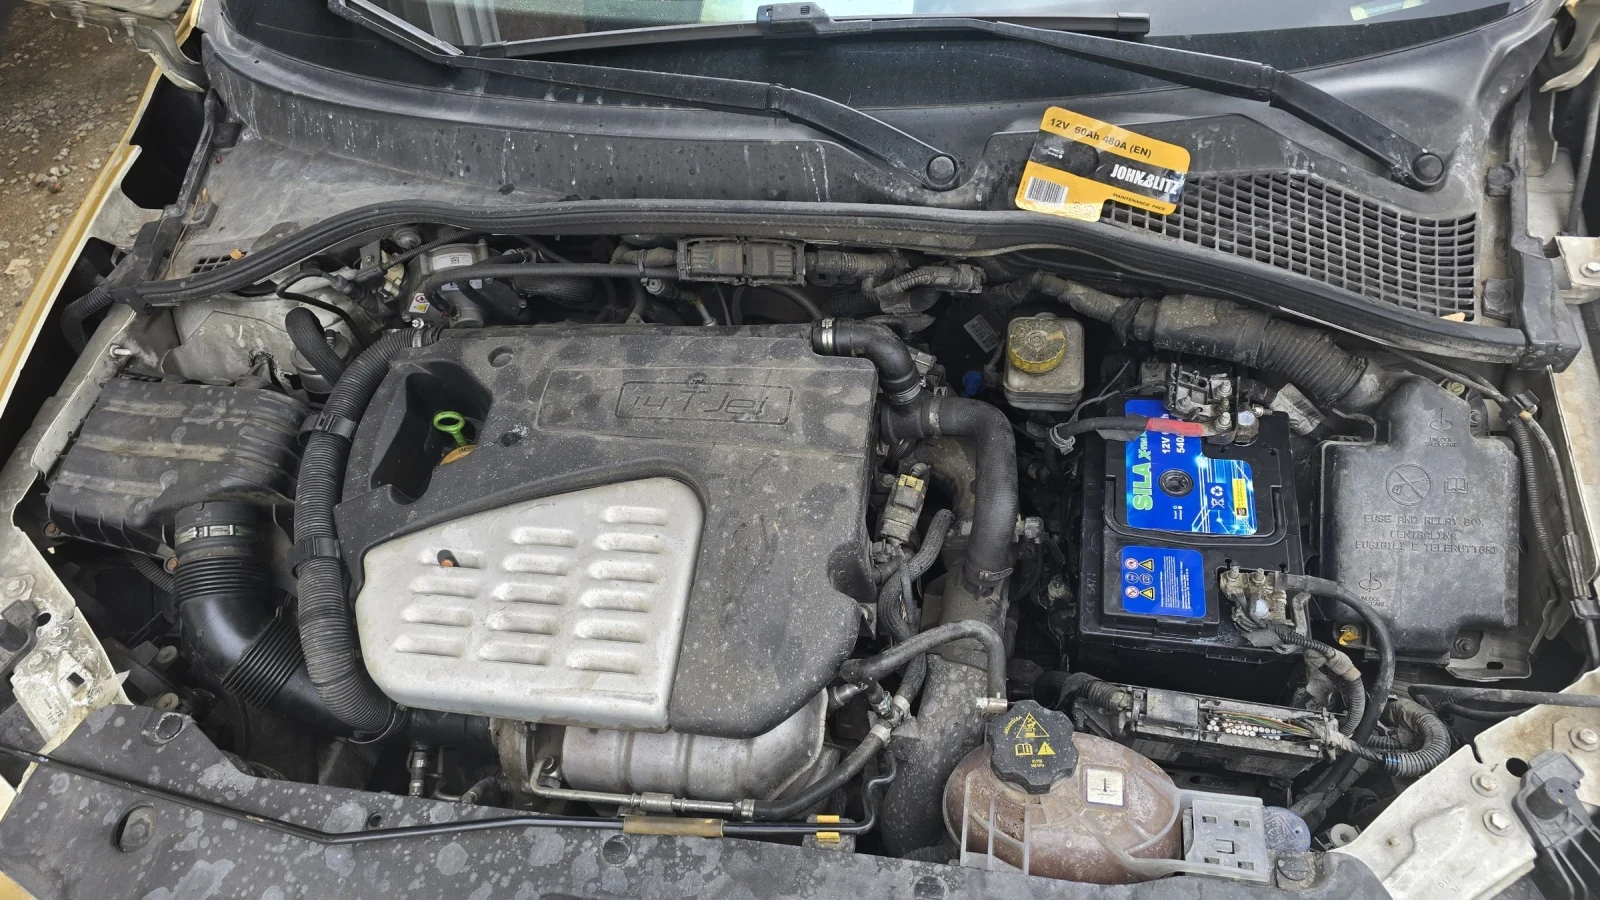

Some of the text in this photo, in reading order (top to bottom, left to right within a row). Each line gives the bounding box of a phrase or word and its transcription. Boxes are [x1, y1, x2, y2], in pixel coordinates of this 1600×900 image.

[1050, 118, 1152, 158] 12V 60Ah 480A (EN)
[1113, 192, 1150, 207] MAINTENANCE
[1162, 437, 1170, 454] 12V
[1132, 462, 1153, 510] SILA
[1364, 515, 1484, 526] FUSE AND RELAY BOX
[1355, 541, 1497, 554] FUSIBILI E TELERUTTORI
